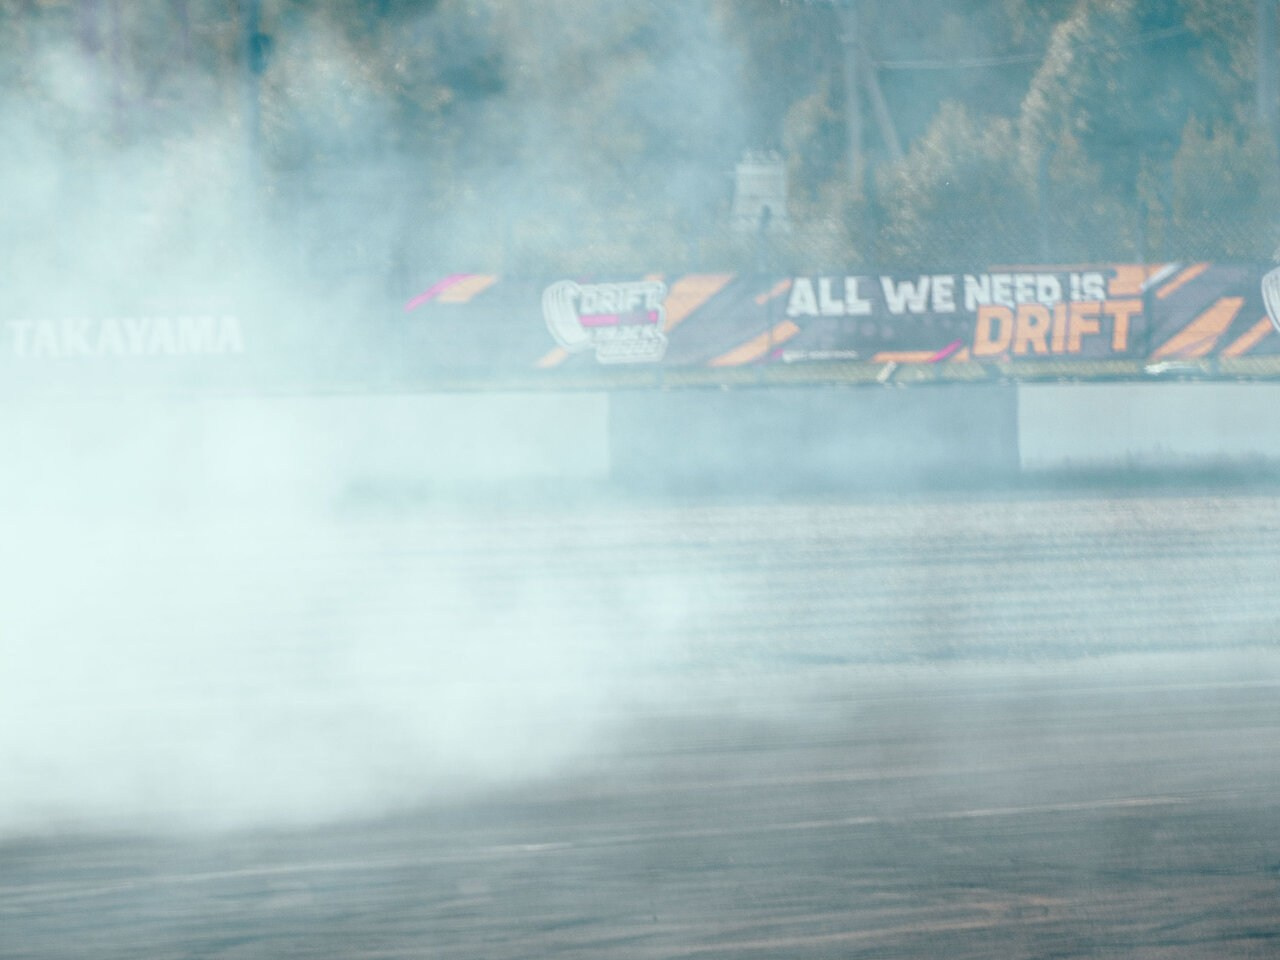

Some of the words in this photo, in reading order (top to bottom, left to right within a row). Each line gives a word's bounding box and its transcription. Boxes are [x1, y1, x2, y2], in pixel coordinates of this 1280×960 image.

[785, 275, 872, 317] ALL
[879, 274, 957, 315] WE
[963, 273, 1061, 313] NEED
[1070, 272, 1106, 301] IS
[6, 314, 246, 360] TAKAYAMA
[973, 299, 1144, 356] DRIFT
